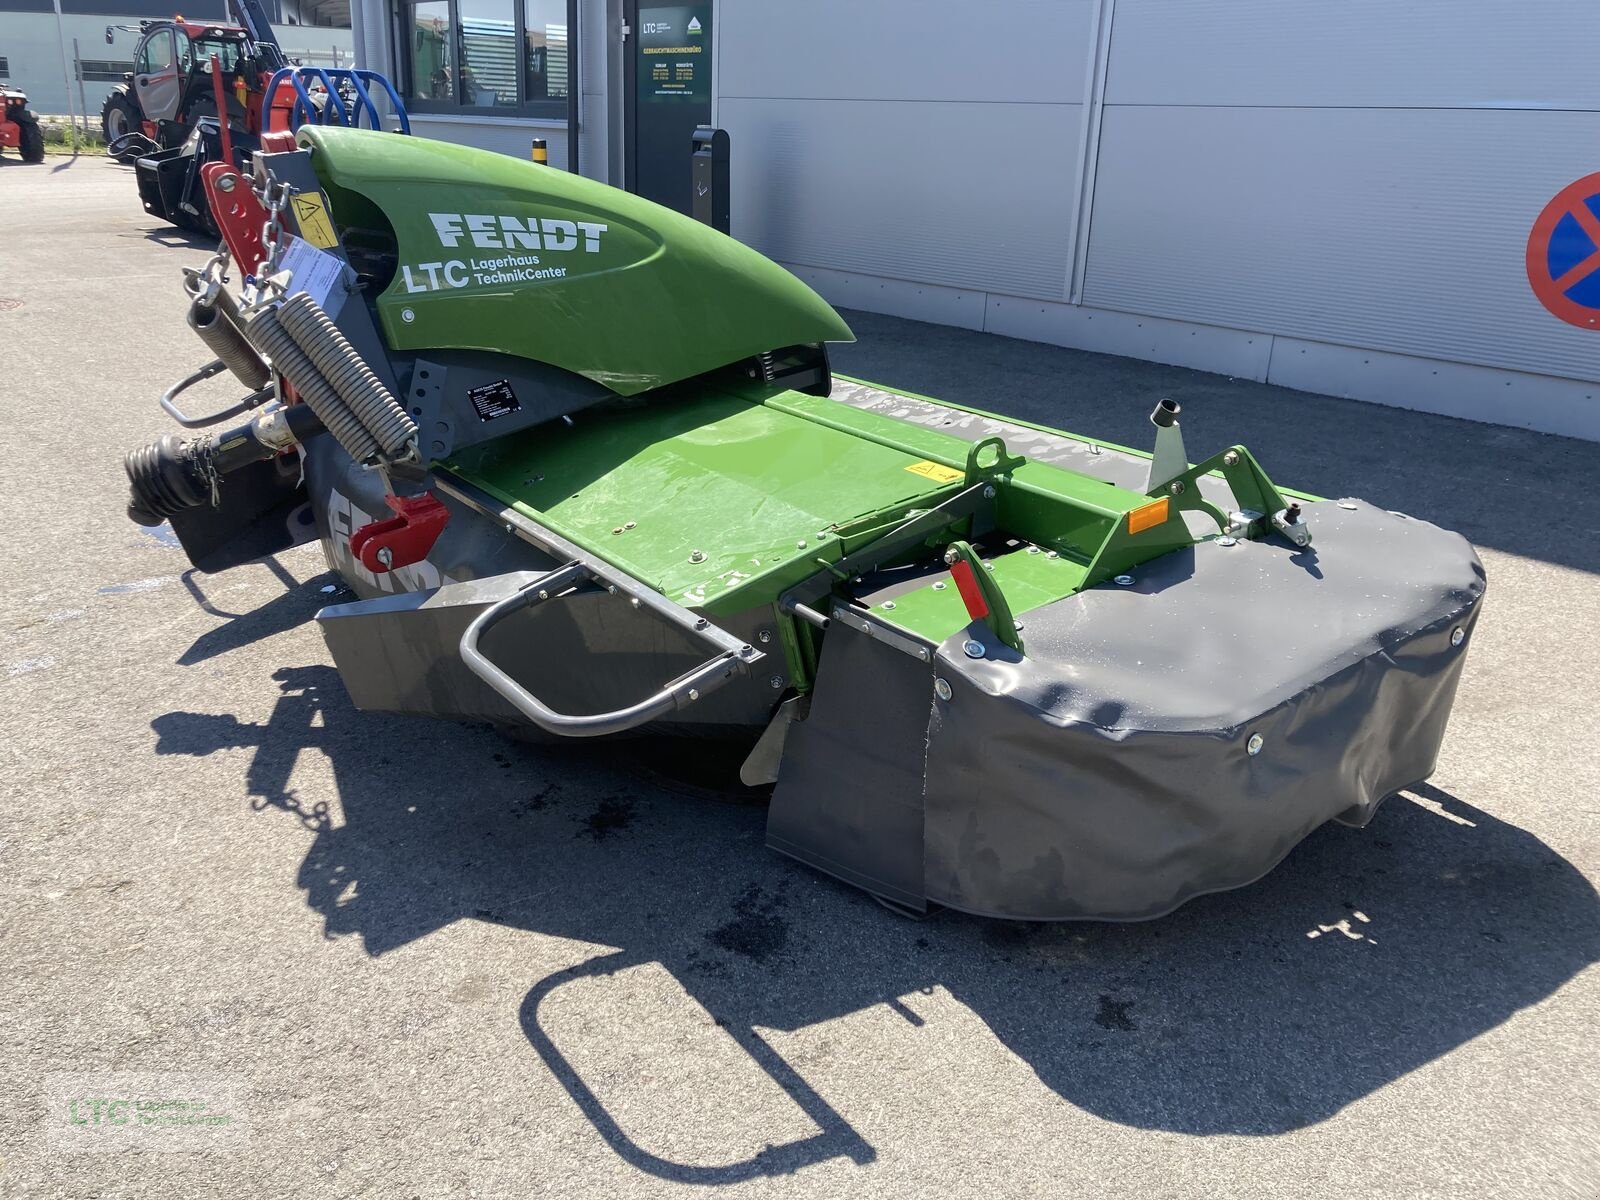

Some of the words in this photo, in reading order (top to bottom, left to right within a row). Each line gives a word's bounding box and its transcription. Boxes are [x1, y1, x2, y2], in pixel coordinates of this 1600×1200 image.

[643, 23, 656, 34] LTC
[428, 212, 608, 253] FENDT
[470, 254, 540, 273] Lagerhaus
[402, 260, 469, 294] LTC
[474, 267, 567, 286] TechnikCenter
